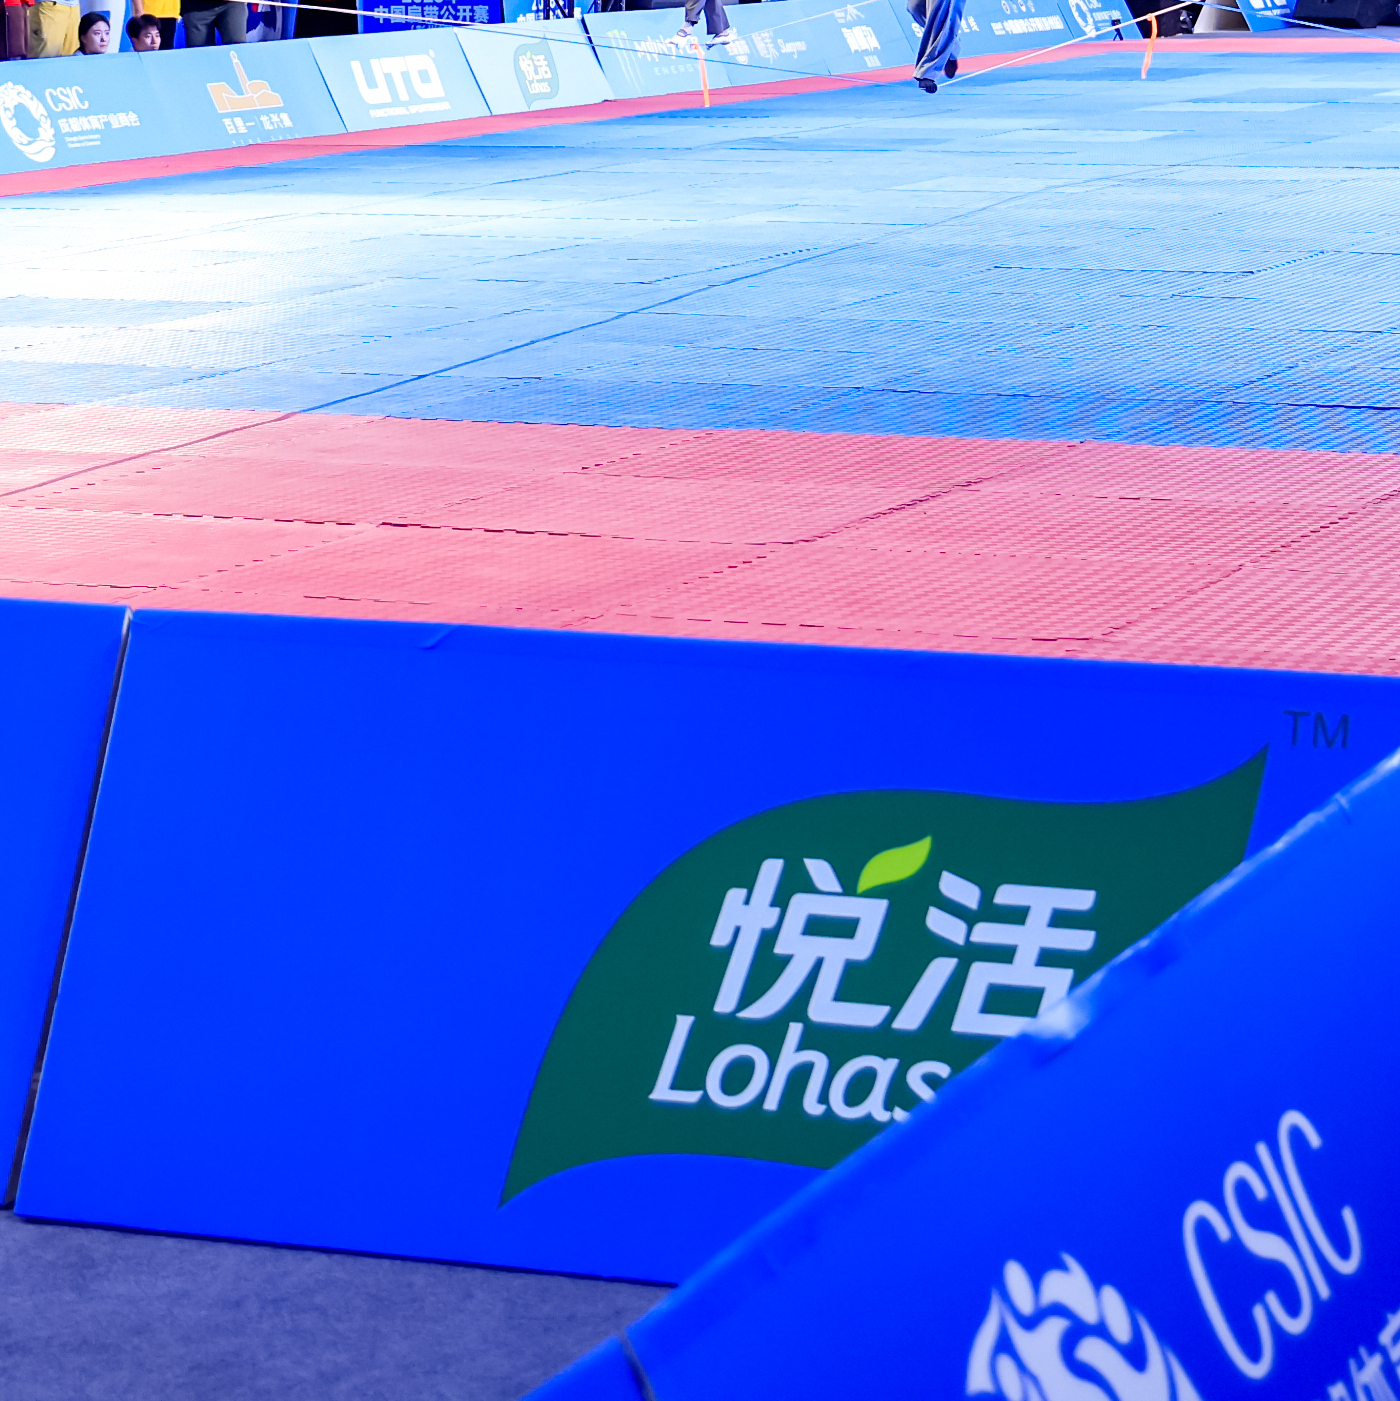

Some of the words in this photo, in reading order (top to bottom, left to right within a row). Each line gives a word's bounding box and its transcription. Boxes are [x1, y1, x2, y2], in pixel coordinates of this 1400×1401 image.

[373, 5, 490, 24] 中国扁带公开赛
[350, 54, 445, 104] UTO
[519, 53, 552, 80] 悦活
[45, 86, 89, 112] CSIC
[58, 111, 140, 134] 成都体育产业商会
[1283, 710, 1351, 749] TM
[710, 856, 1097, 1038] 悦活
[649, 1014, 955, 1122] Lohas
[1183, 1109, 1362, 1379] CSIC
